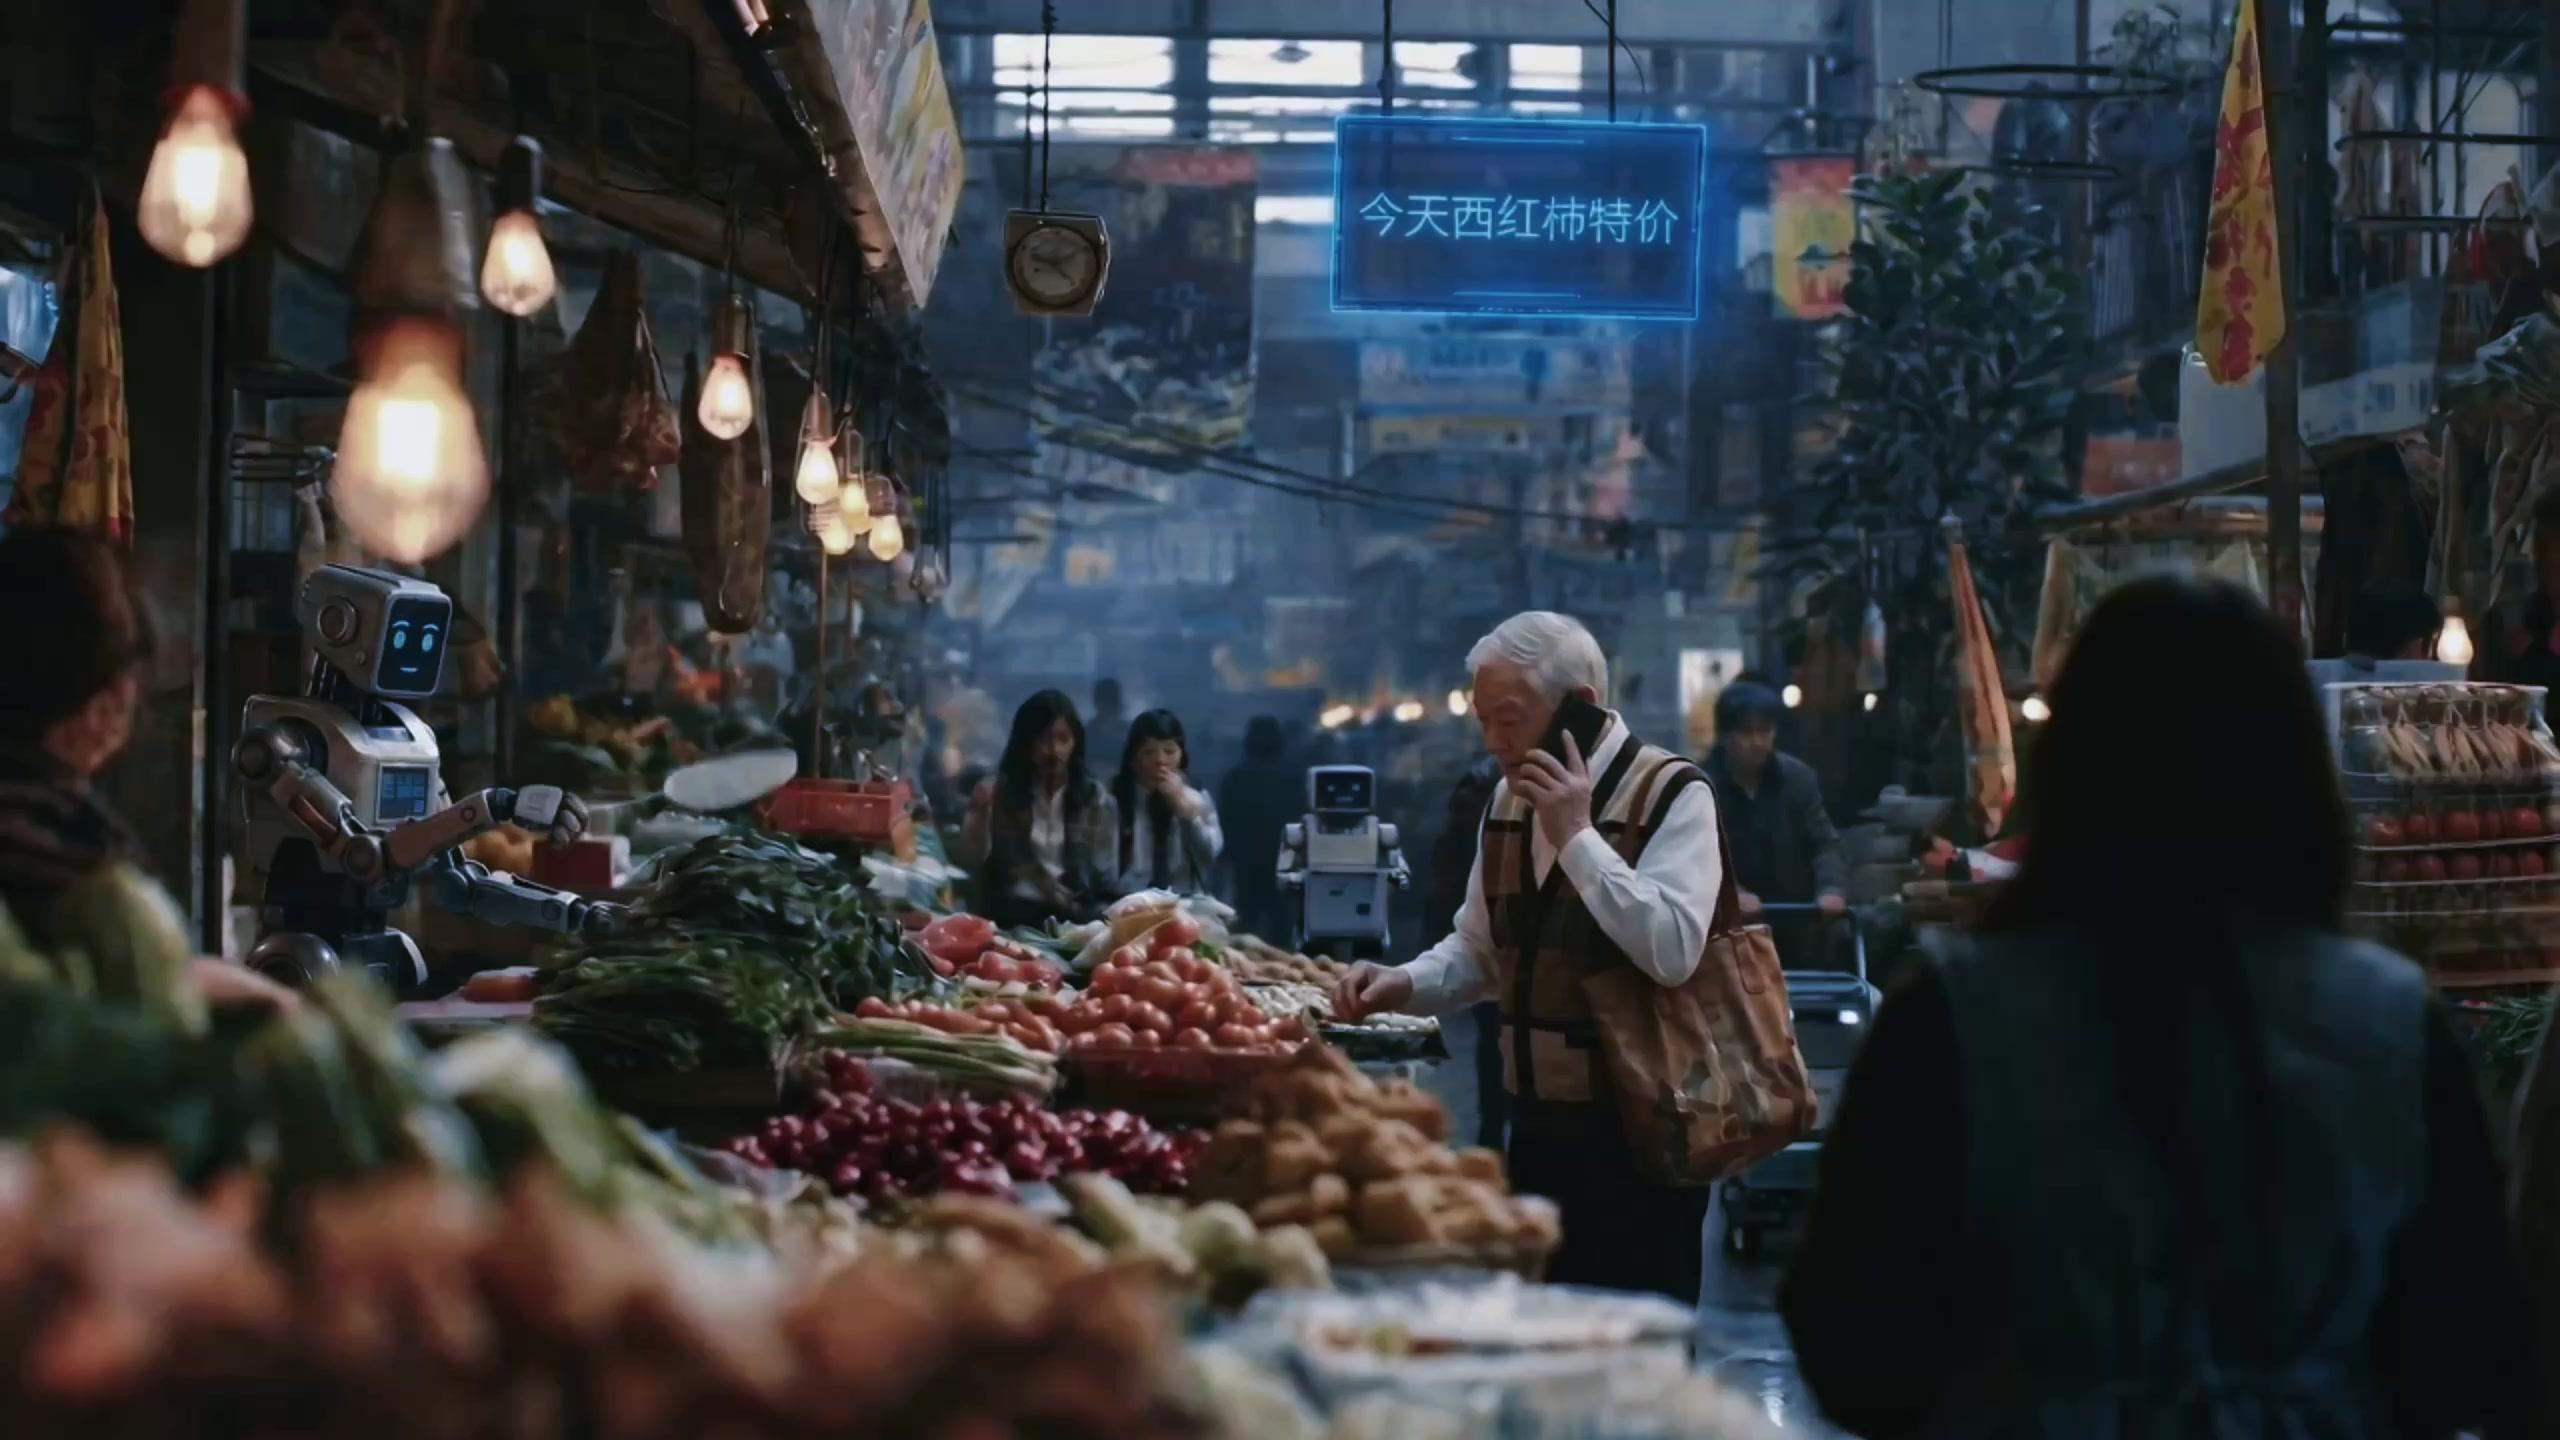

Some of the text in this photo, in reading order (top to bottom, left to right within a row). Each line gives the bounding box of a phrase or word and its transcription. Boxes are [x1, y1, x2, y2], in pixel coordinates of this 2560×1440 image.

[1359, 191, 1680, 244] 今天西红柿特价
